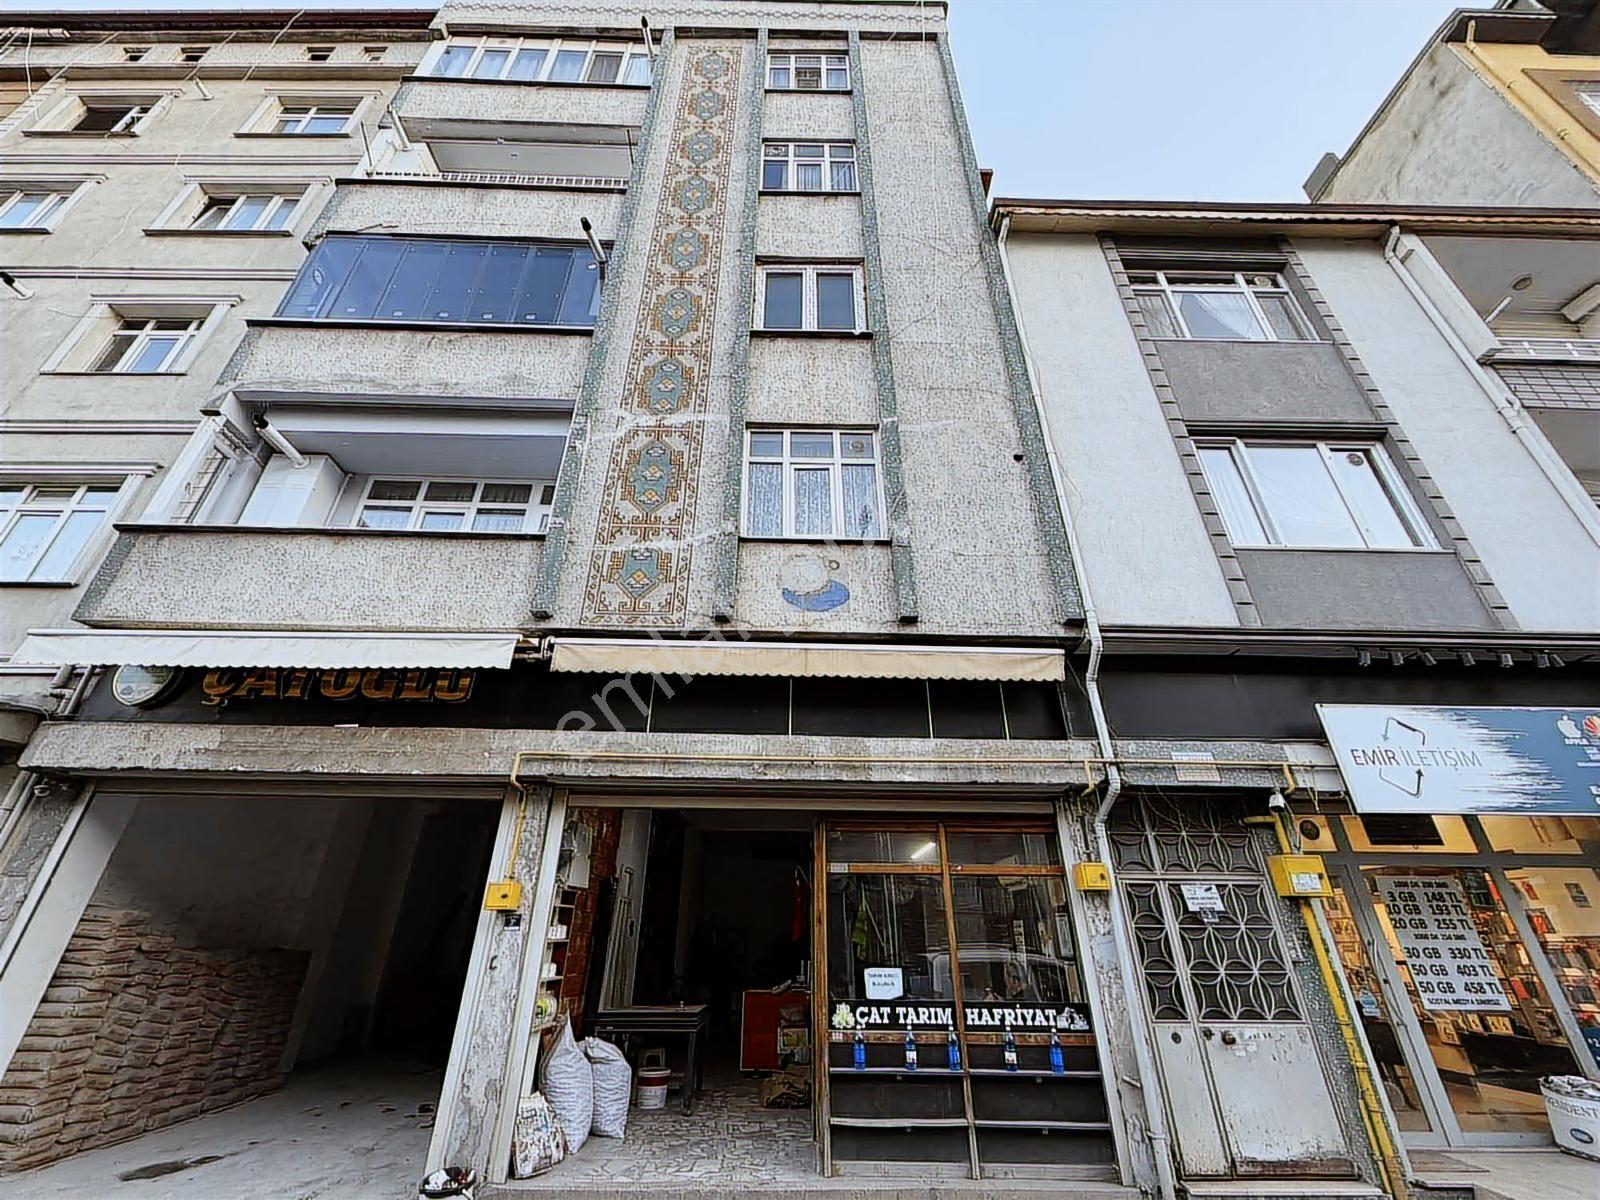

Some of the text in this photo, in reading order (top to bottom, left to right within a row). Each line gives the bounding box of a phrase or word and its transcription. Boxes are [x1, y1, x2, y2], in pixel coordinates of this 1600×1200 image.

[1350, 745, 1482, 771] EMİR İLETİŞİM
[1387, 891, 1463, 903] 3 GB 148 TL
[1386, 903, 1468, 916] 10 GB 193 TL
[1390, 918, 1474, 930] 20 GB 255 TL
[1403, 947, 1488, 960] 30 GB 330 TL
[1411, 964, 1496, 977] 50 GB 403 TL
[1418, 981, 1504, 995] 50 GB 458 TL
[856, 1003, 1057, 1029] ÇAT TARIM HAFRİYAT
